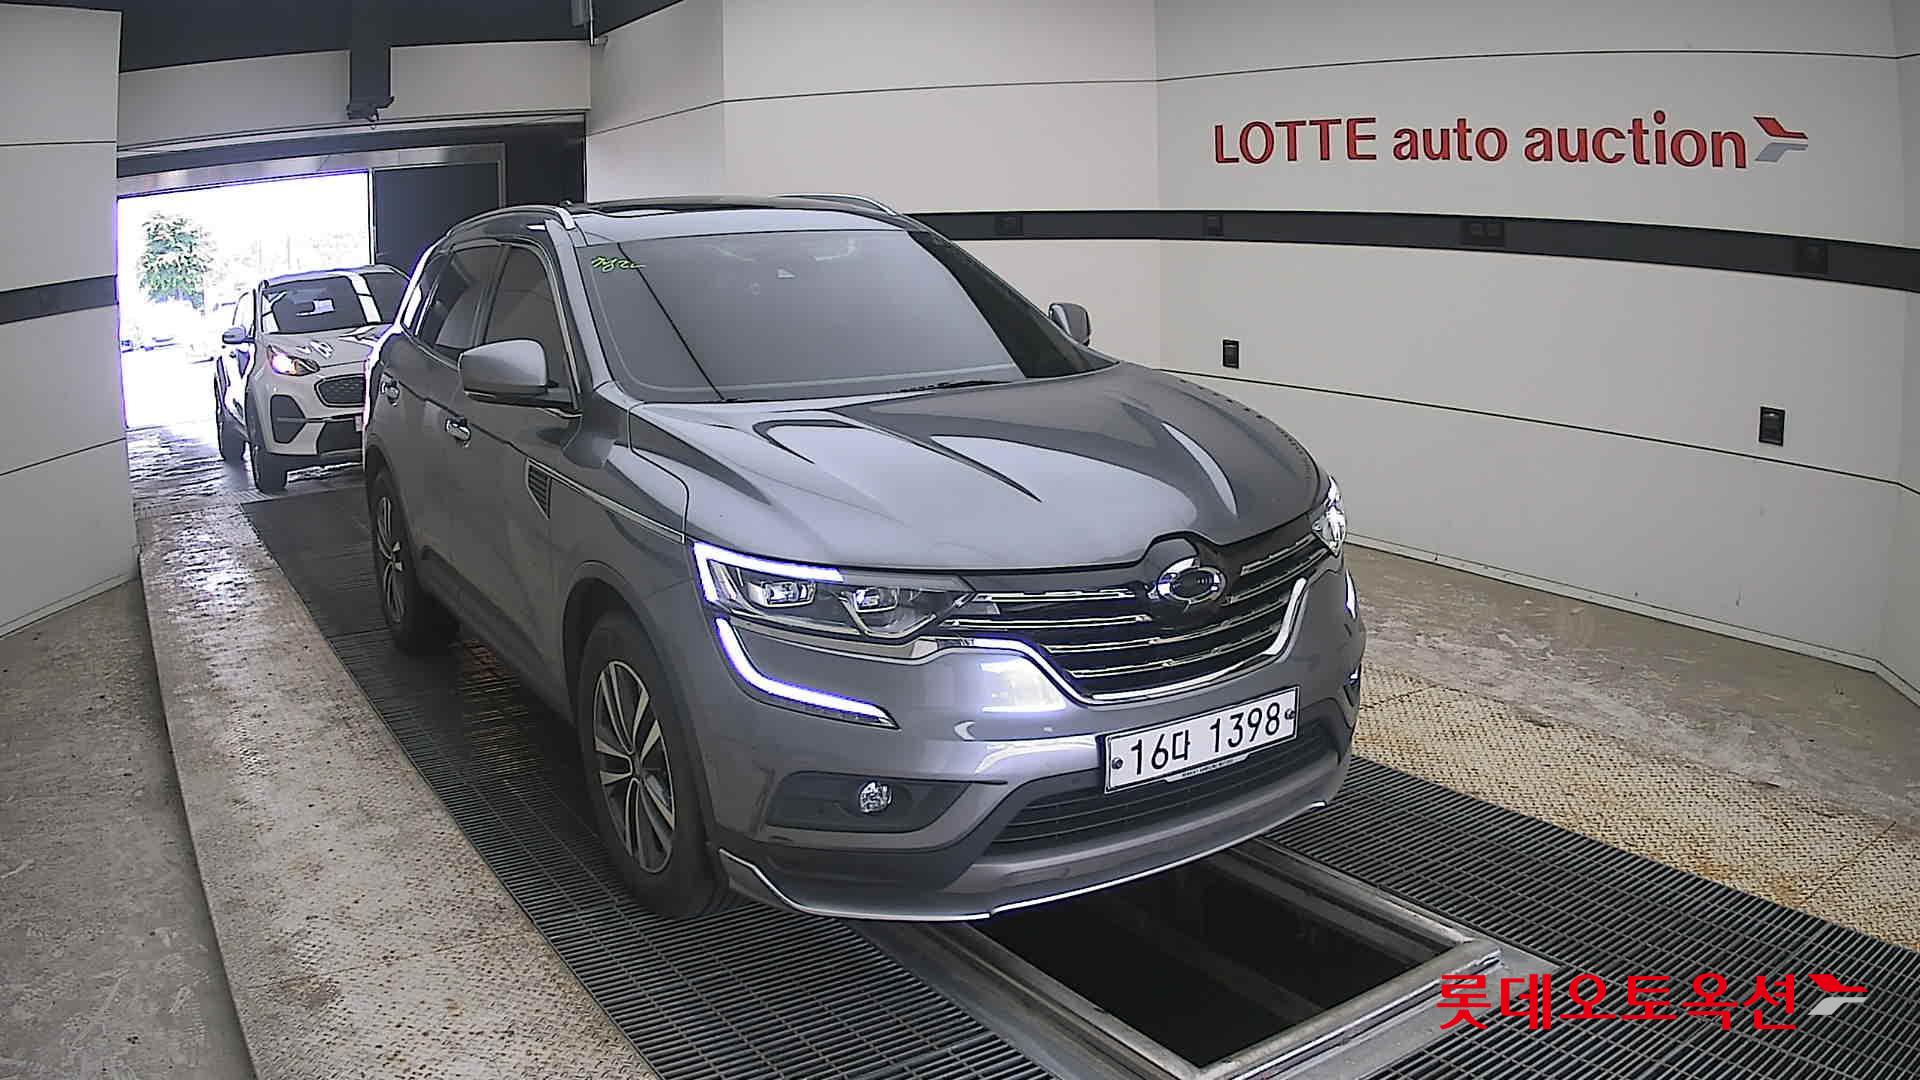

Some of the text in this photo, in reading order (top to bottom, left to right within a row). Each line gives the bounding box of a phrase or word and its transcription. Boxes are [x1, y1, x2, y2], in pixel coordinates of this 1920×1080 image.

[1214, 110, 1748, 169] LOTTE auto auction
[1130, 728, 1191, 776] 16다
[1209, 702, 1281, 753] 1398
